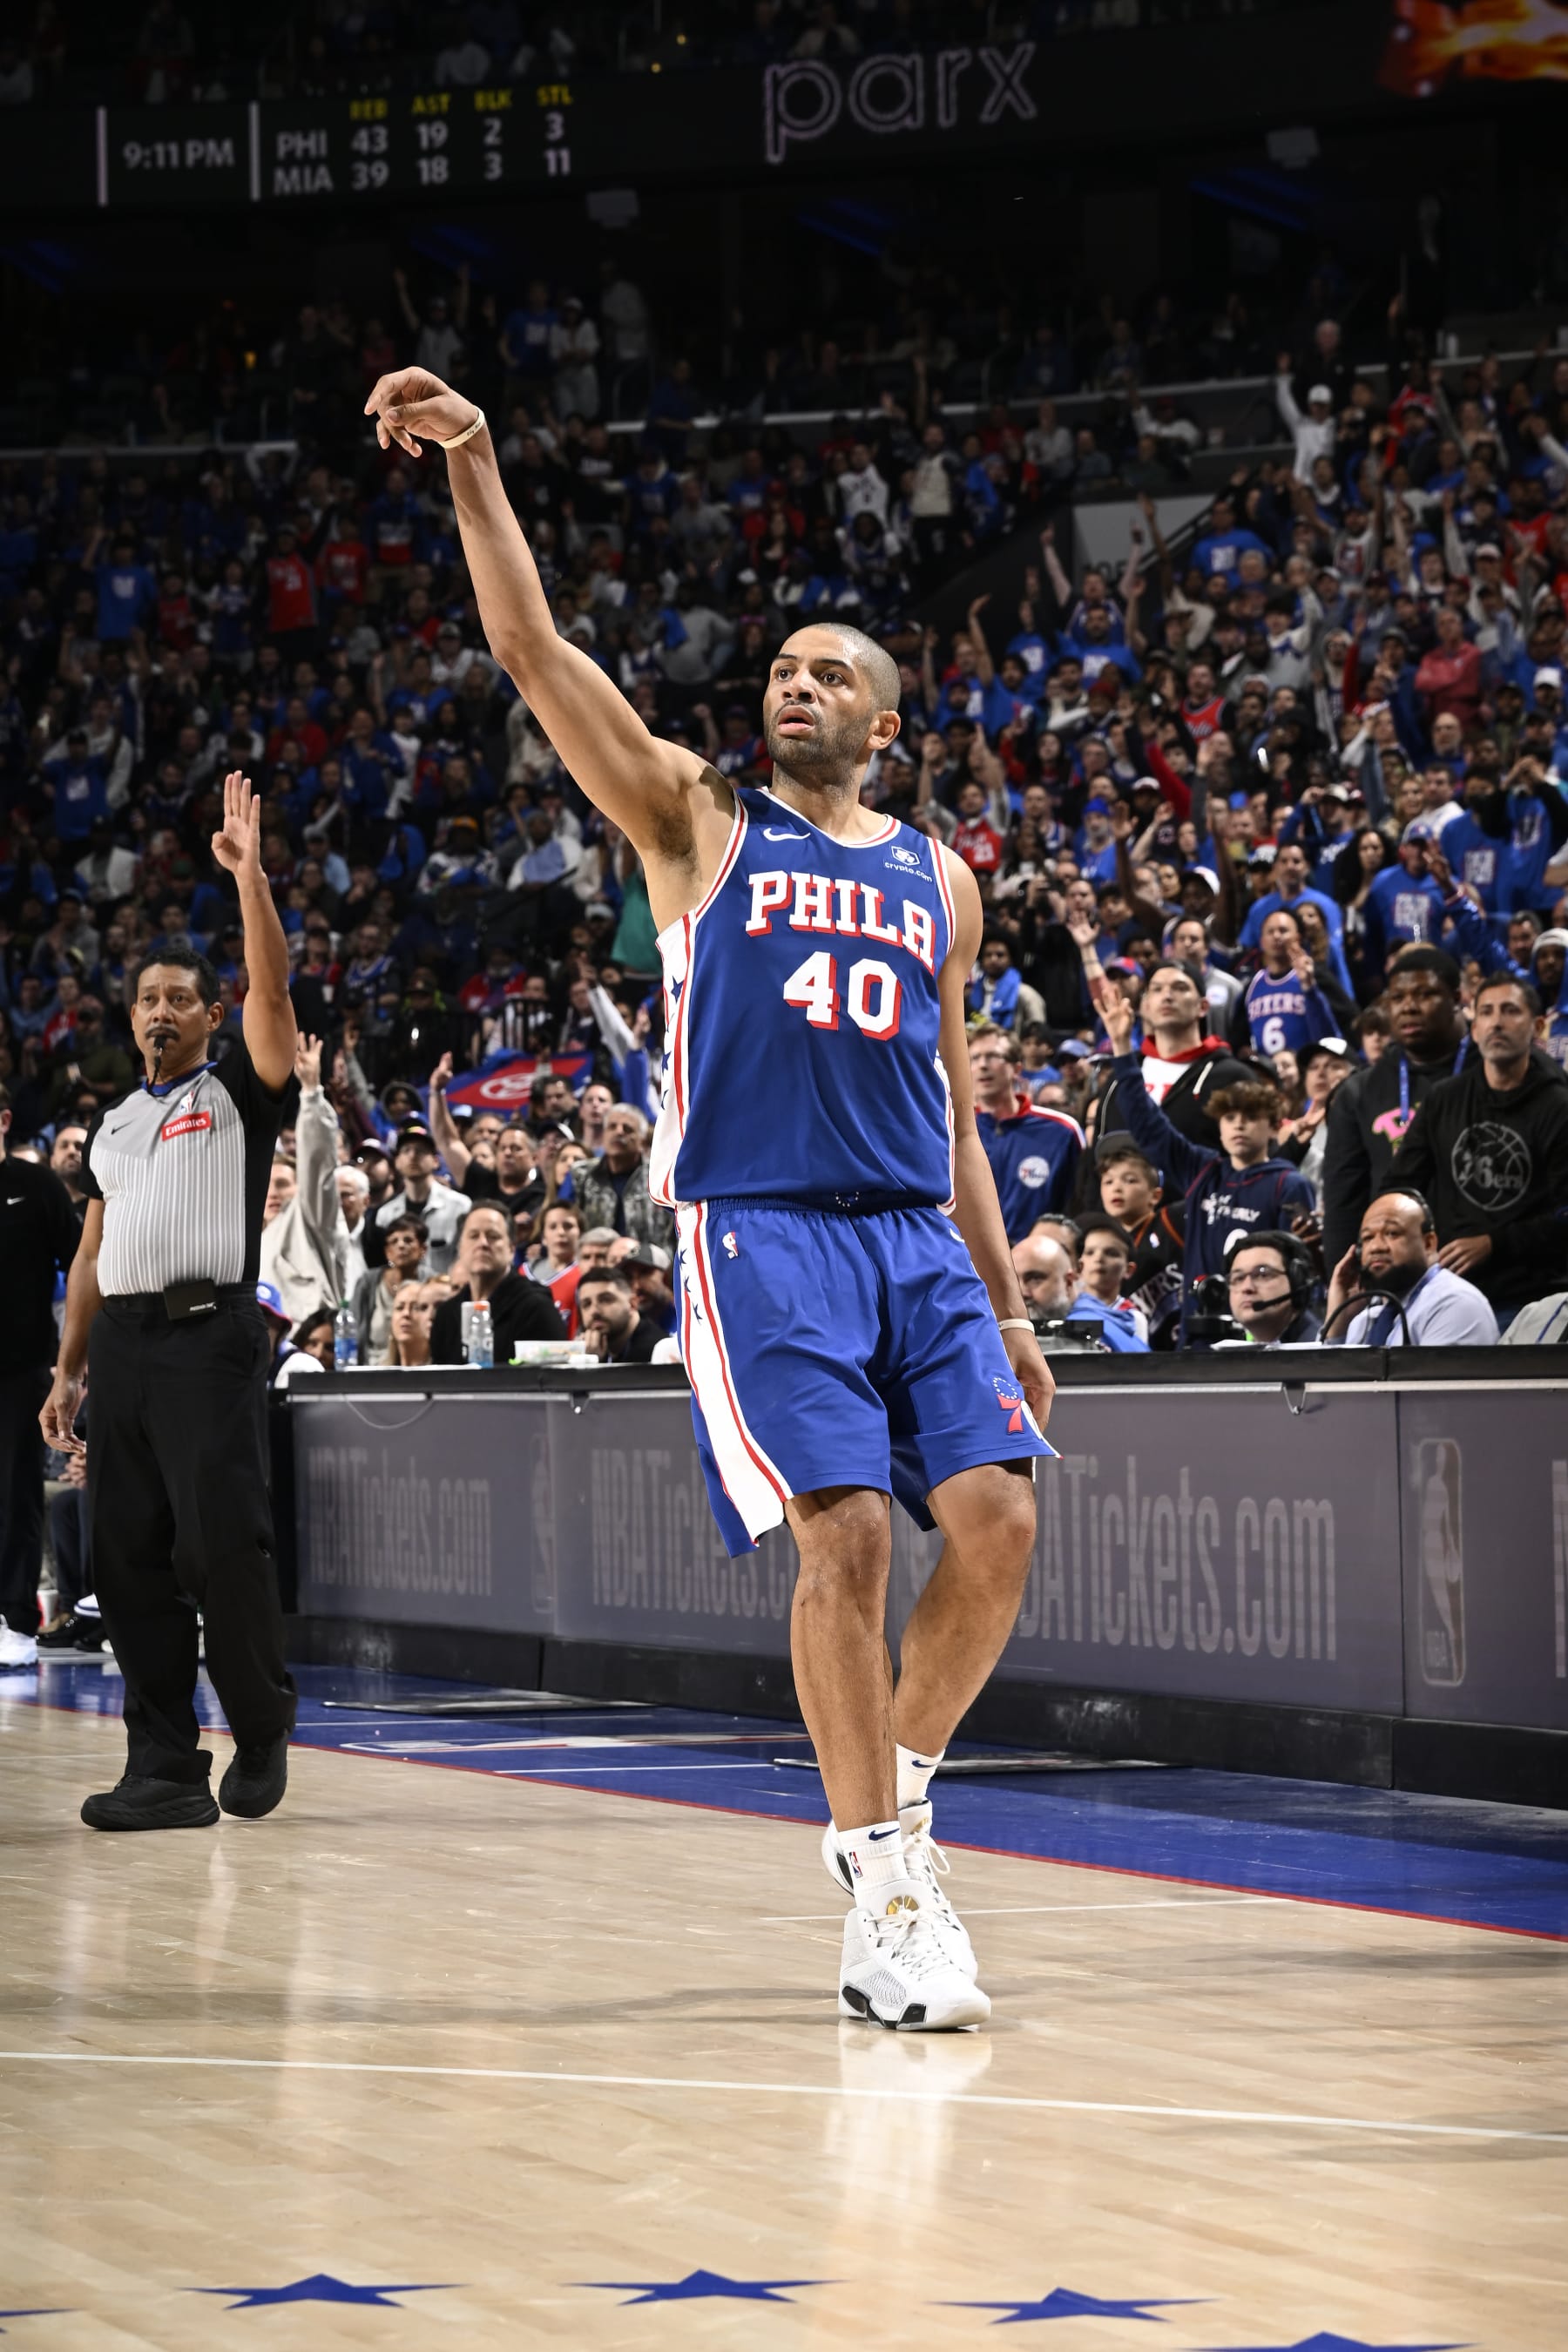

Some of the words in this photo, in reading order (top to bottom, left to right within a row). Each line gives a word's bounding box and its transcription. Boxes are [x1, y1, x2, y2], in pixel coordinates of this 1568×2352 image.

[350, 99, 389, 120] REB
[412, 94, 450, 114] AST
[475, 90, 512, 111] BLK
[537, 85, 572, 106] STL
[764, 43, 1037, 163] parx
[123, 141, 179, 169] 9:11
[186, 138, 234, 168] PM
[276, 130, 328, 159] PHI
[352, 125, 389, 153] 43
[416, 120, 449, 150] 19
[483, 118, 503, 146] 2
[545, 112, 564, 140] 3
[274, 165, 333, 195] MIA
[352, 160, 389, 190] 39
[417, 155, 449, 185] 18
[484, 152, 503, 179] 3
[544, 147, 571, 176] 11
[884, 861, 933, 882] crypto.com
[746, 870, 936, 977] PHILA
[783, 950, 903, 1041] 40
[1262, 1017, 1286, 1056] 6
[165, 1117, 206, 1137] Emirates
[308, 1447, 491, 1597] NBATickets.com
